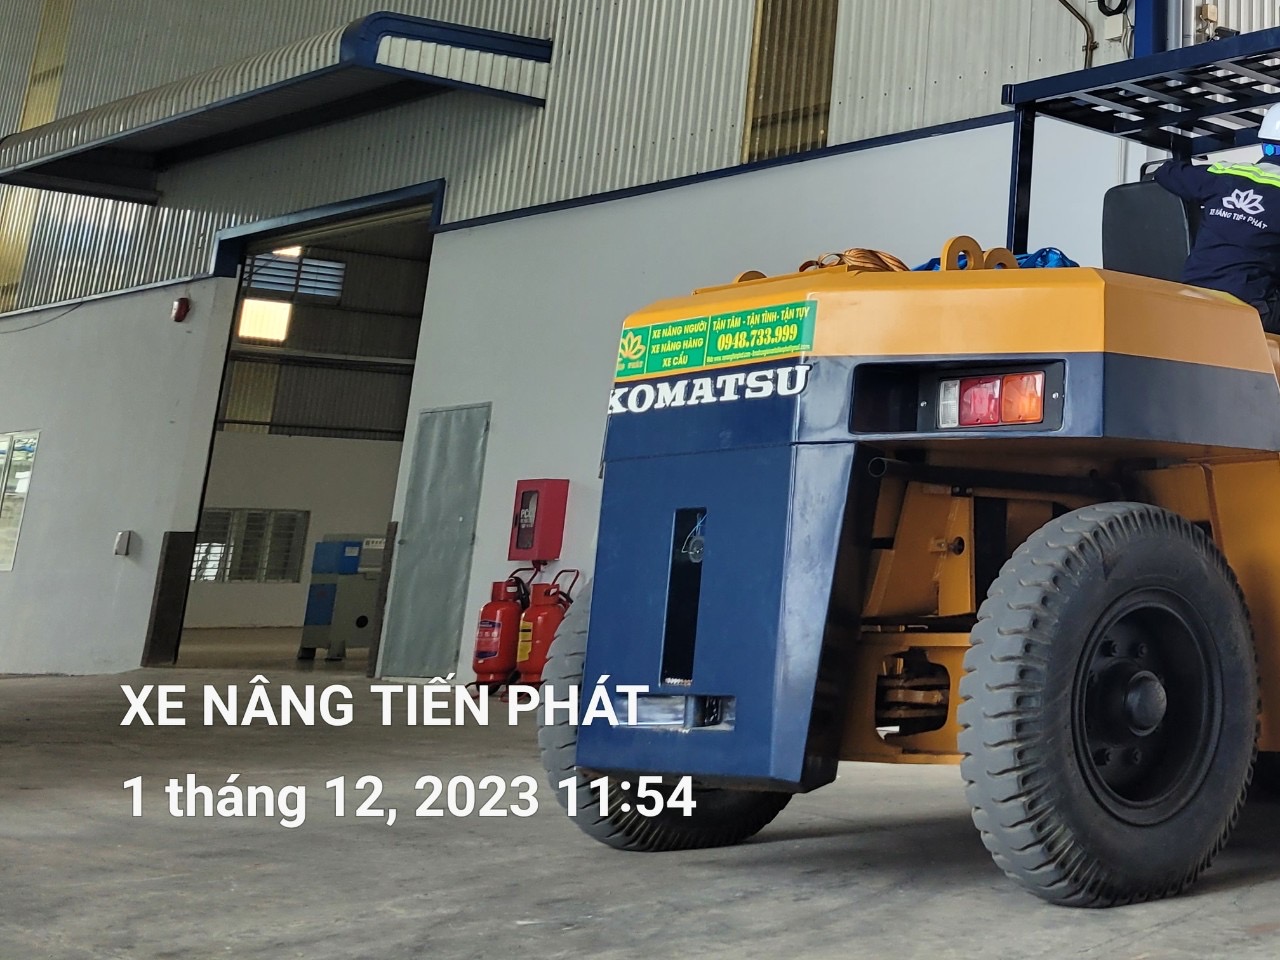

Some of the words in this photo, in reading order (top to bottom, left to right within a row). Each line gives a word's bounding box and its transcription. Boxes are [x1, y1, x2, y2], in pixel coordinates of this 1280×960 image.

[652, 329, 661, 339] XE
[662, 324, 682, 338] NÂNG
[683, 319, 707, 334] NGƯỜI
[713, 317, 726, 333] TẬN
[727, 315, 741, 329] TÂM
[746, 312, 760, 328] TẬN
[781, 306, 794, 323] TẬN
[651, 344, 660, 354] XE
[661, 340, 681, 353] NÂNG
[682, 336, 704, 350] HÀNG
[717, 323, 798, 352] 0948.733.999
[662, 357, 672, 368] XE
[608, 364, 812, 414] KOMATSU
